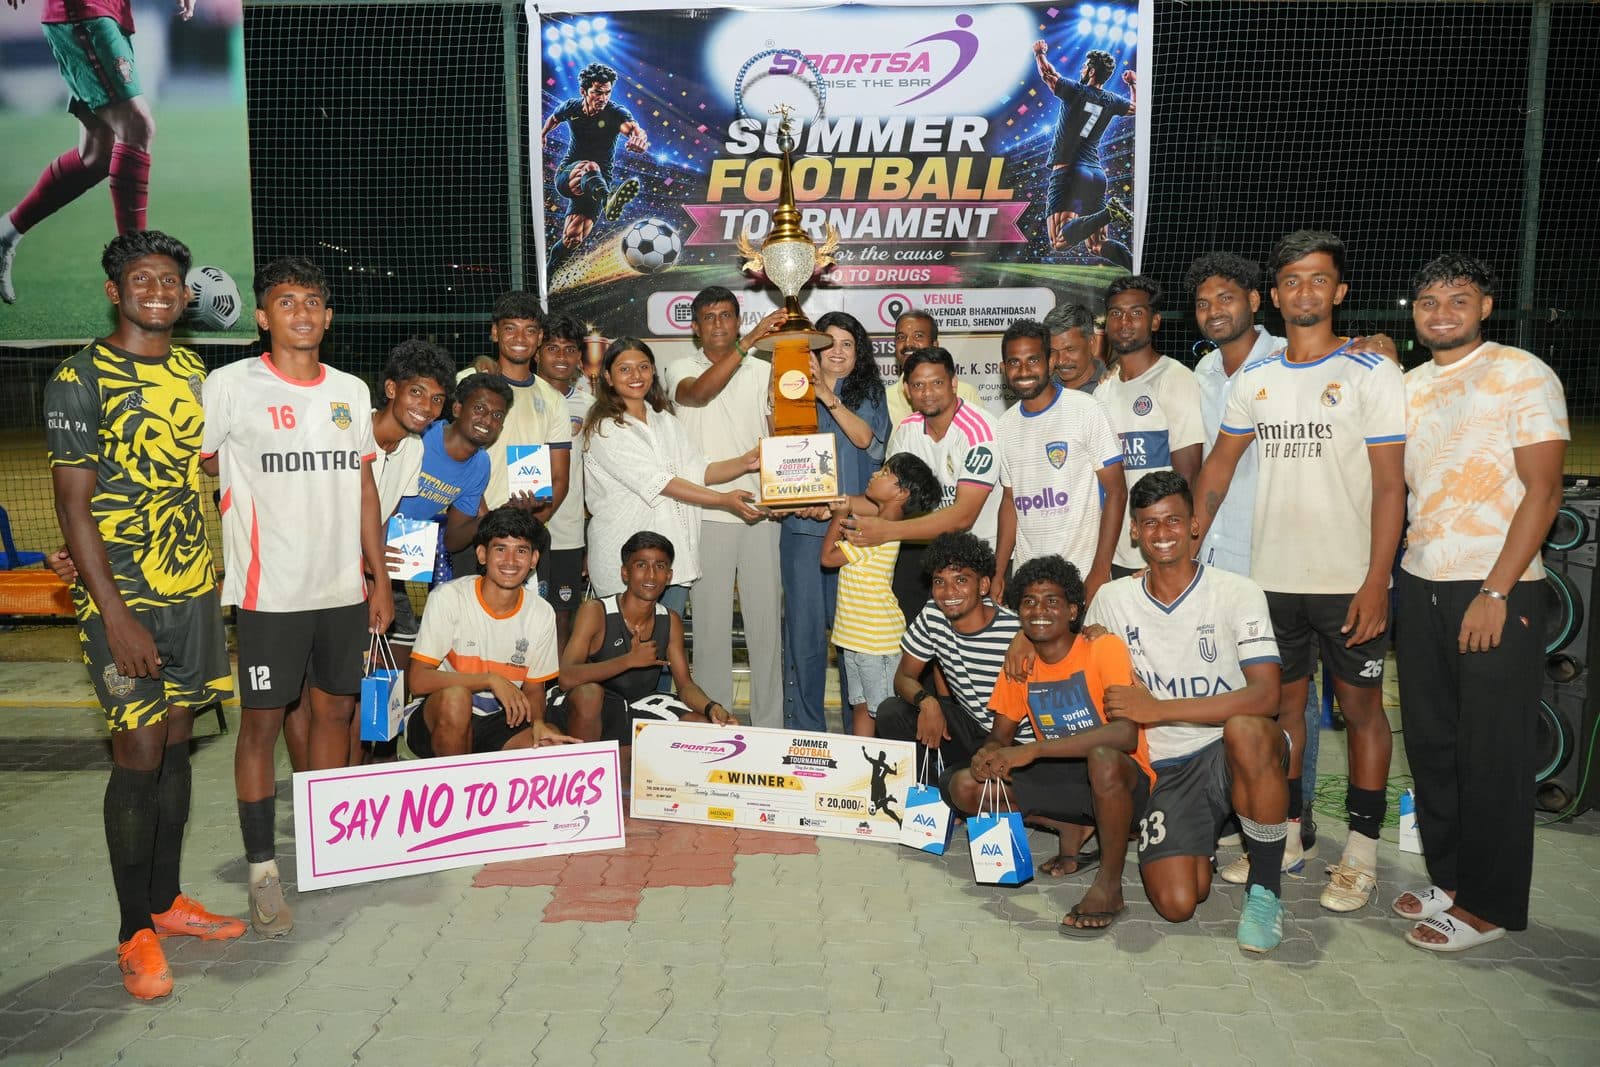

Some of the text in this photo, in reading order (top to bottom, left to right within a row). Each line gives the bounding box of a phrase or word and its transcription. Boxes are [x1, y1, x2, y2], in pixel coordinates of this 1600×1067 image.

[768, 49, 930, 75] SPORTSA
[861, 79, 894, 88] THE
[898, 79, 931, 88] BAR
[1080, 102, 1103, 138] 7
[725, 115, 989, 155] SUMMER
[706, 157, 1015, 202] FOOTBALL
[719, 207, 999, 241] TORNAMENT
[834, 246, 945, 261] or the cause
[849, 269, 870, 282] TO
[875, 268, 931, 282] DRUGS
[923, 294, 963, 305] VENUE
[969, 307, 1037, 316] BHARATHIDASAN
[973, 318, 1005, 327] SHENOY
[971, 363, 981, 375] K.
[267, 405, 295, 430] 16
[1257, 420, 1333, 441] Emirates
[1119, 437, 1147, 455] TAR
[1265, 442, 1322, 458] FLY BETTER
[966, 447, 992, 474] hp
[518, 465, 541, 476] AVA
[776, 484, 825, 495] WINNER
[1015, 488, 1069, 516] apollo
[400, 543, 425, 558] AVA
[1358, 660, 1383, 678] 26
[249, 666, 271, 691] 12
[1062, 707, 1090, 721] sprint
[1066, 719, 1094, 731] to the
[670, 742, 726, 753] SPORTSA
[792, 738, 829, 749] SUMMER
[788, 746, 832, 758] FOOTBALL
[790, 756, 830, 766] TOURNAMENT
[879, 766, 885, 776] 7
[727, 771, 785, 788] WINNER
[325, 767, 606, 844] SAY NO TO DRUGS
[827, 797, 865, 811] 20,000/-
[912, 813, 937, 829] AVA
[1138, 811, 1167, 852] 33
[981, 843, 1003, 856] AVA
